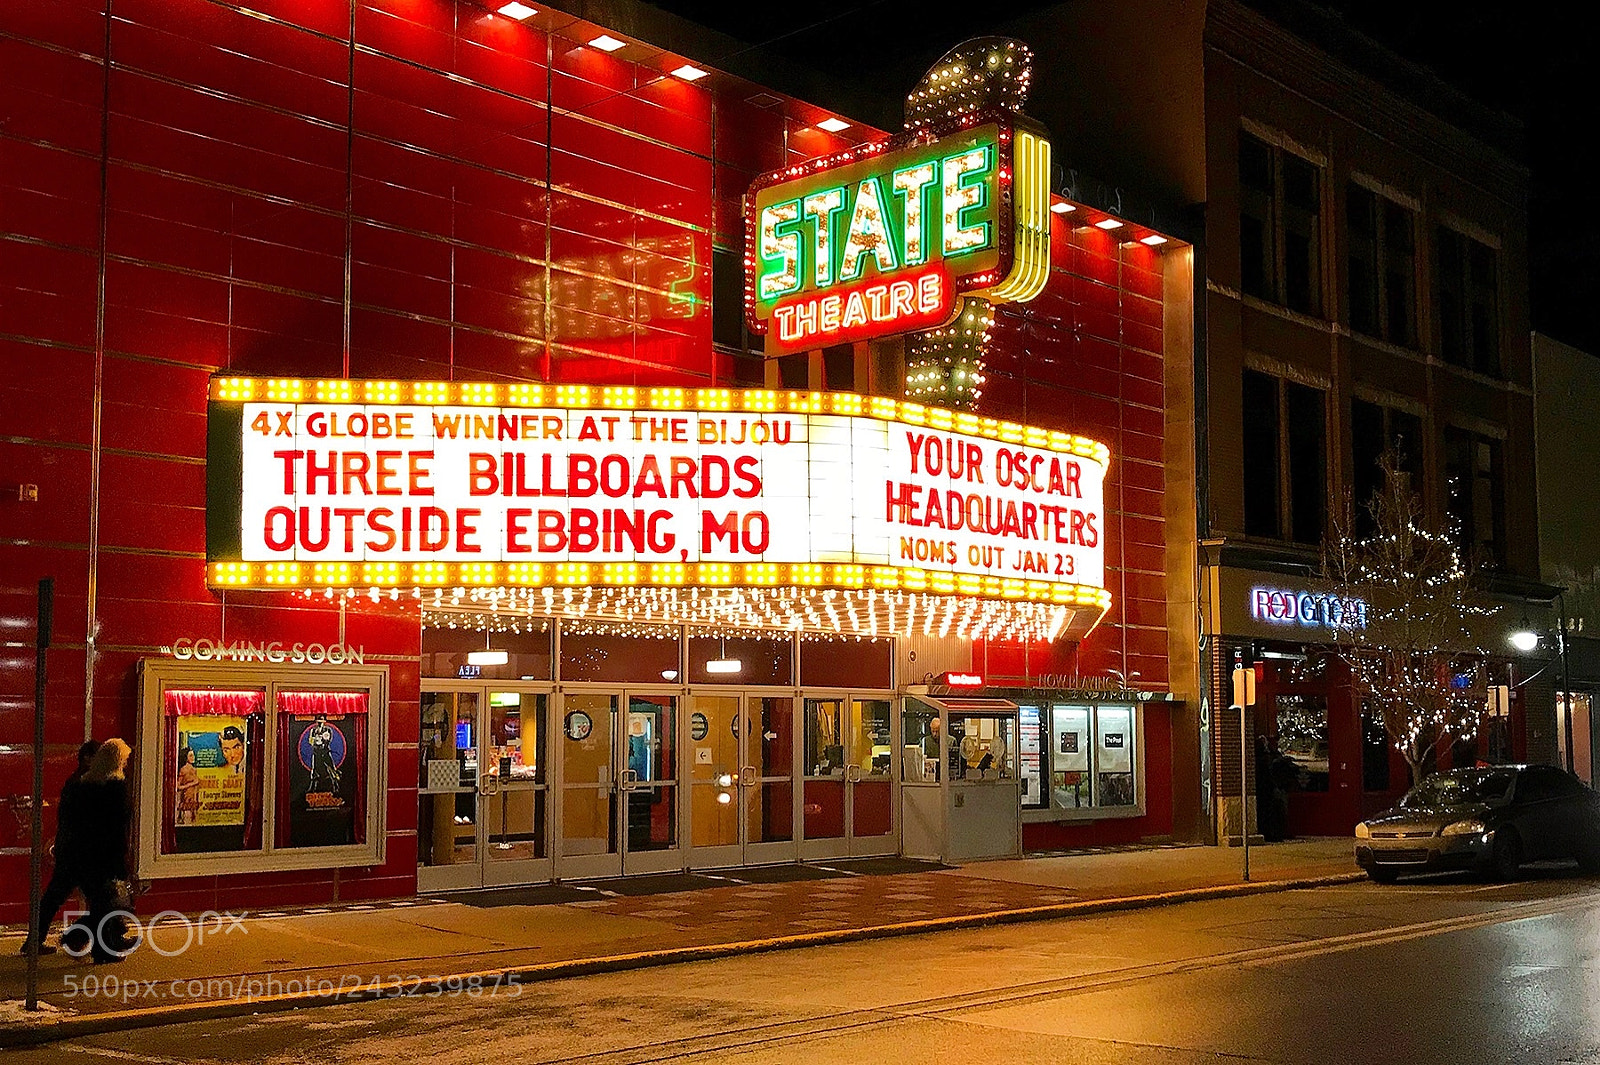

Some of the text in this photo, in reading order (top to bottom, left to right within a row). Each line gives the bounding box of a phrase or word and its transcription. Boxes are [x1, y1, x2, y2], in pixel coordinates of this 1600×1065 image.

[760, 144, 996, 299] STATE
[774, 273, 942, 341] THEATRE
[251, 410, 793, 446] 4X GLOBE WINNER AT THE BIJOU
[273, 449, 763, 498] THREE BILLBOARDS
[906, 431, 1083, 499] YOUR OSCAR
[263, 505, 770, 562] OUTSIDE EBBING, MO
[885, 480, 1098, 548] HEADQUARTERS
[900, 536, 1075, 576] NOMS OUT JAN 23
[173, 637, 365, 665] COMING SOON
